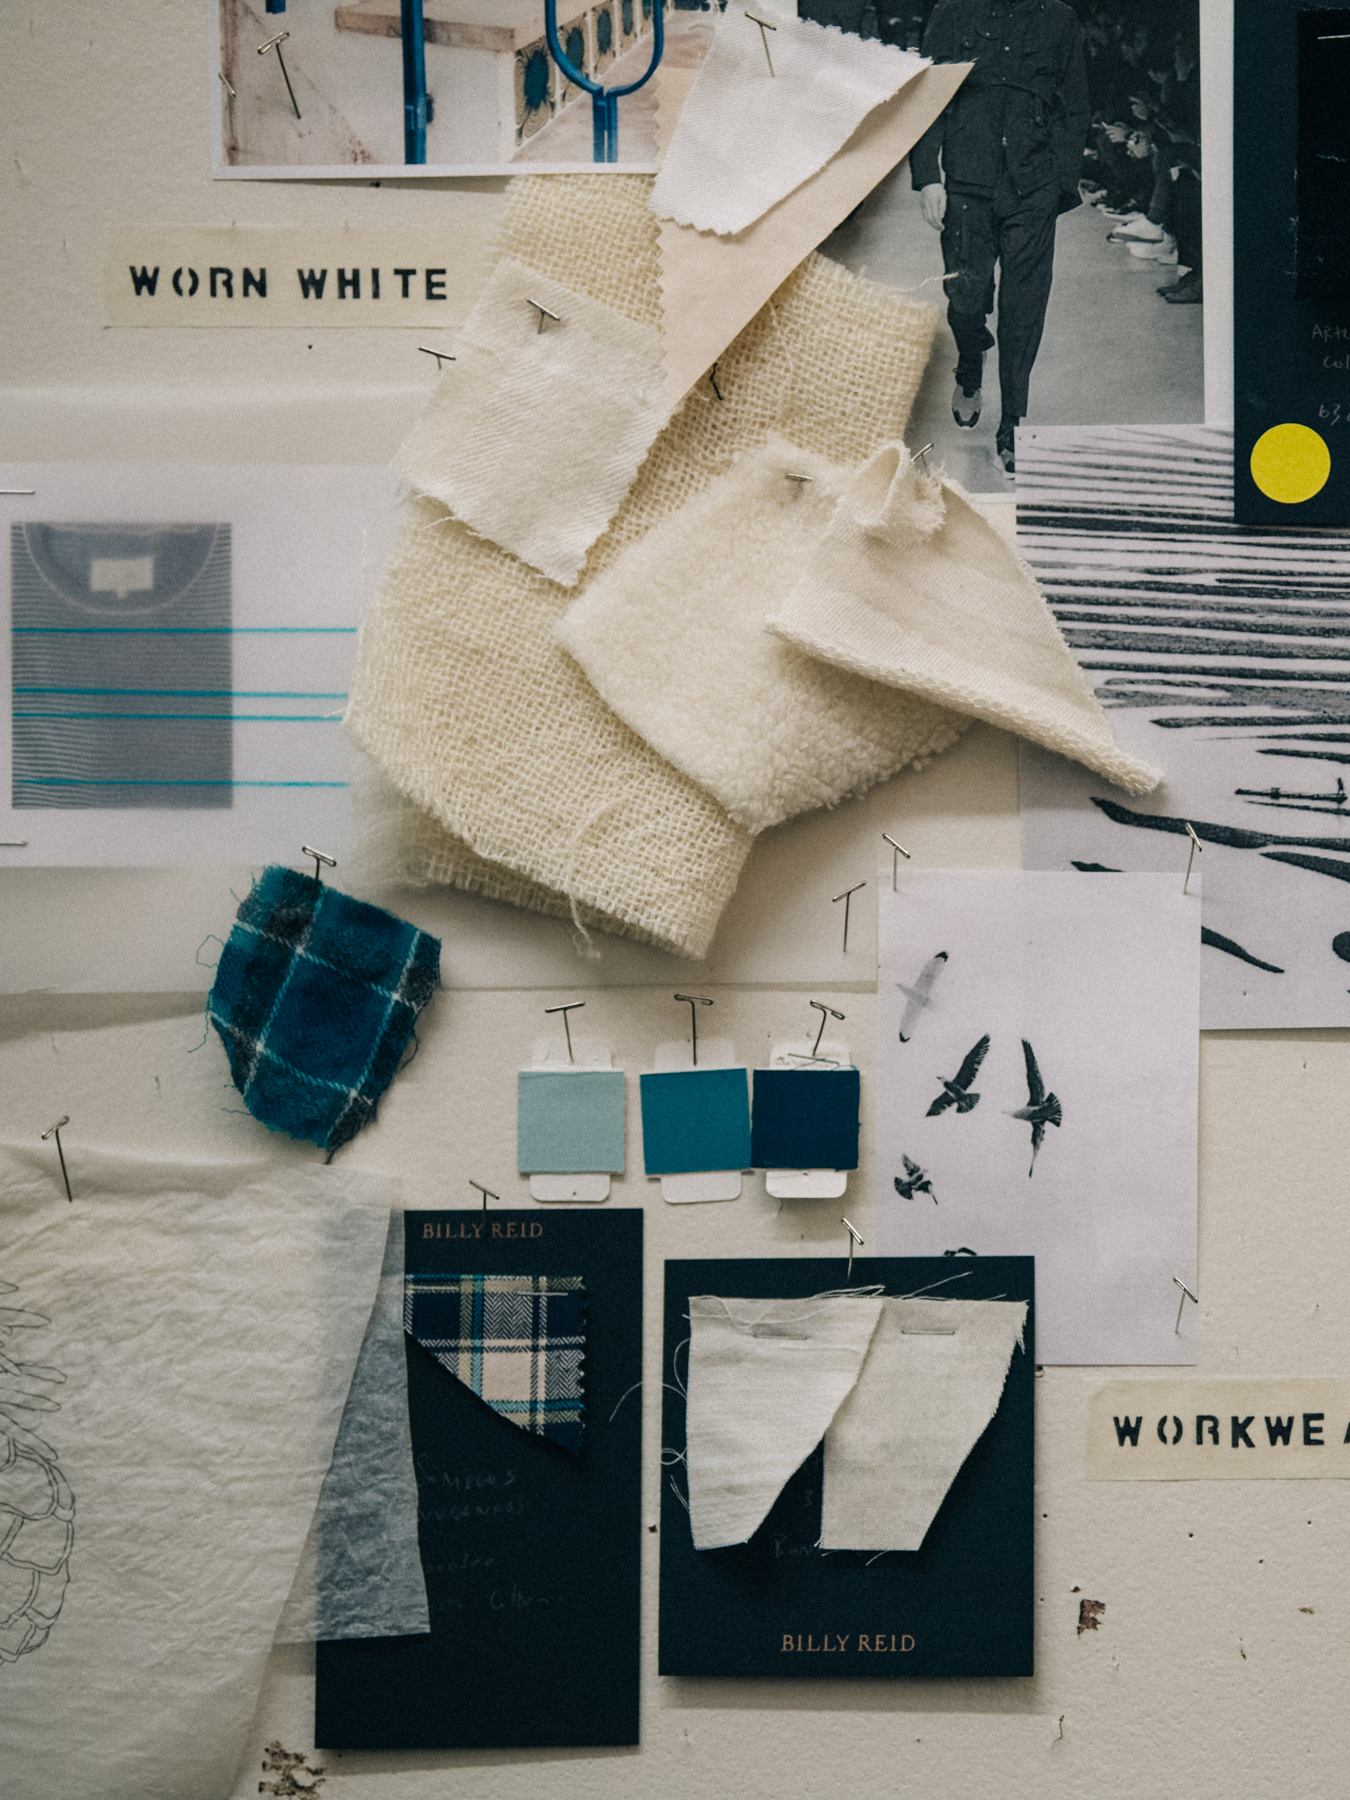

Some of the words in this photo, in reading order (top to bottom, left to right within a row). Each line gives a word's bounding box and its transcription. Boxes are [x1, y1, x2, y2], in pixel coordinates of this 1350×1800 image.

[130, 266, 266, 298] WORN
[298, 269, 446, 300] WHITE
[423, 1223, 482, 1238] BILLY
[492, 1222, 542, 1238] REID
[782, 1634, 849, 1651] BILLY
[858, 1635, 915, 1651] REID
